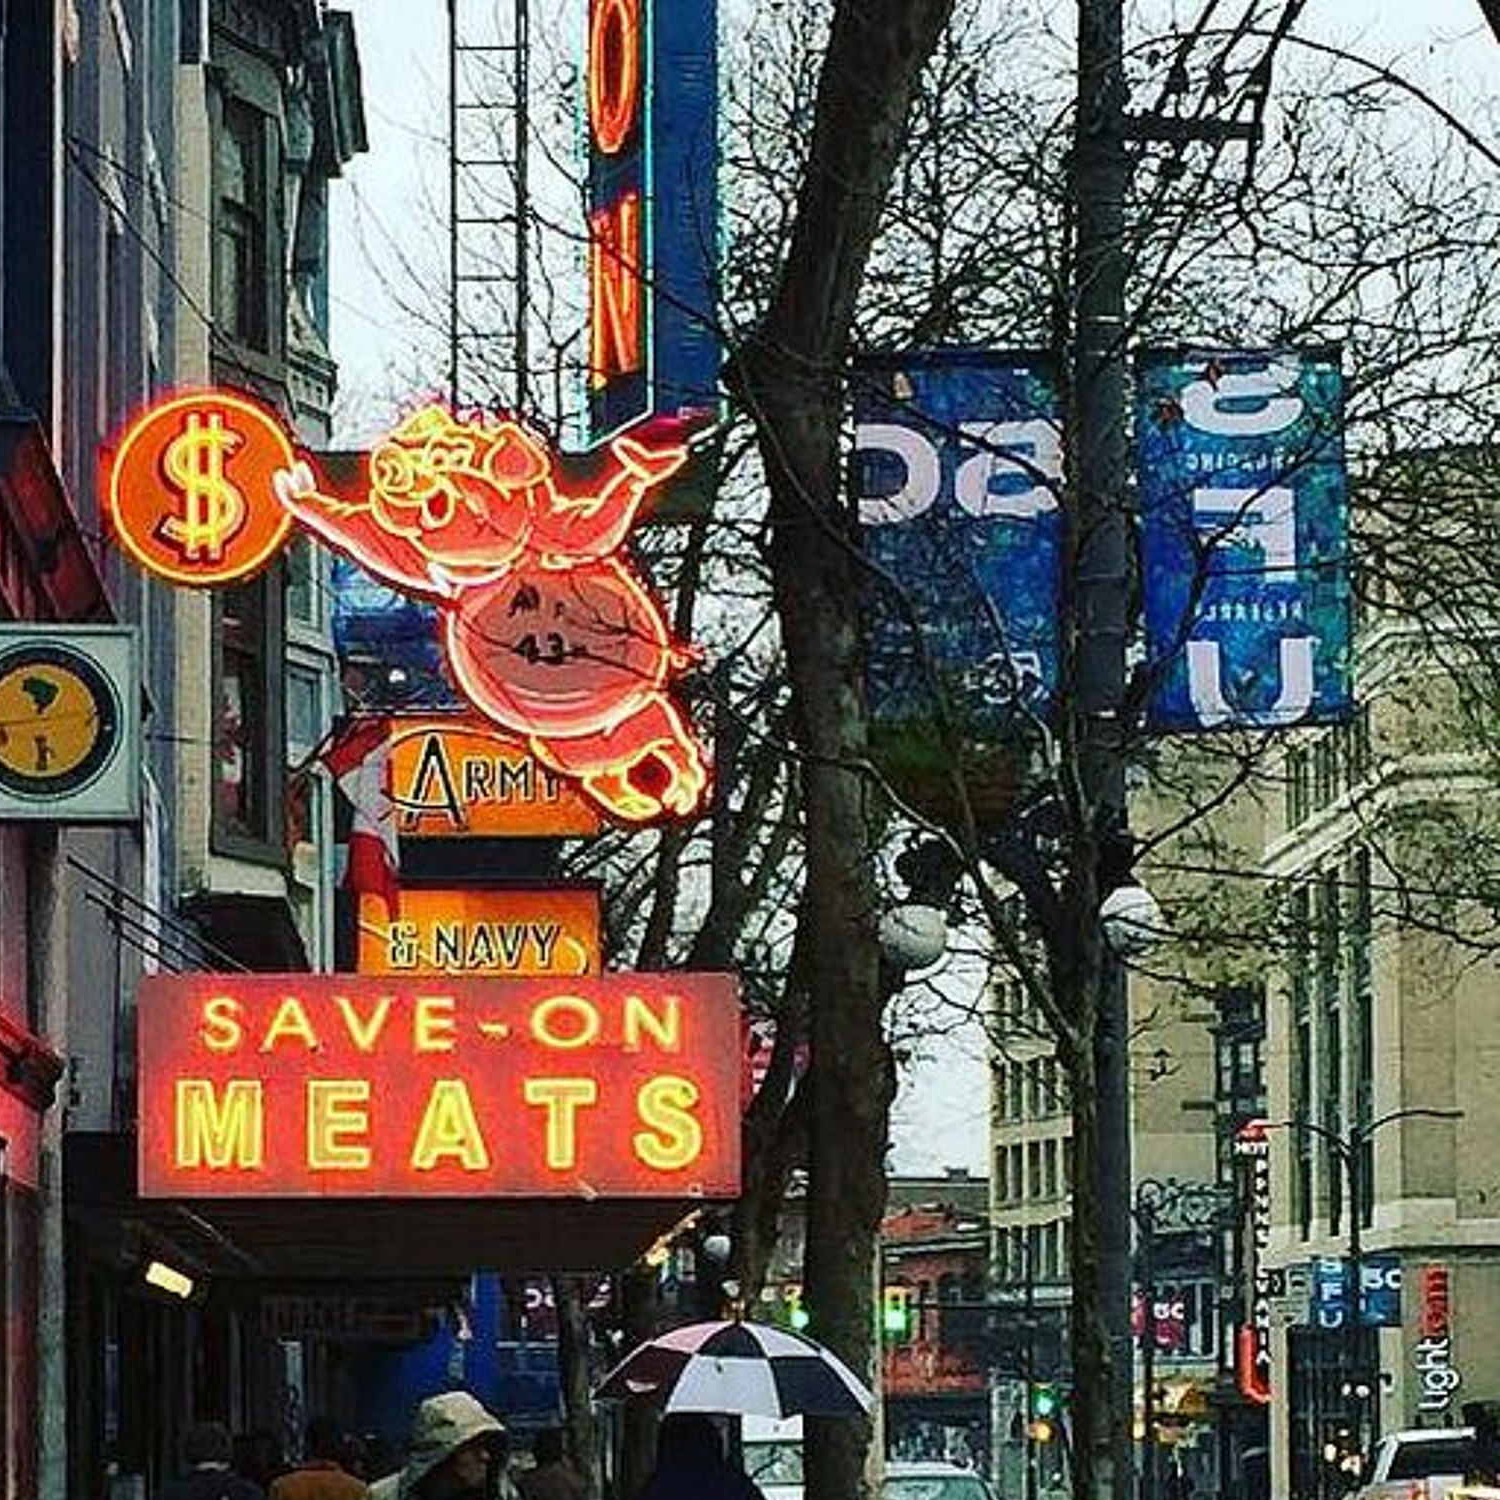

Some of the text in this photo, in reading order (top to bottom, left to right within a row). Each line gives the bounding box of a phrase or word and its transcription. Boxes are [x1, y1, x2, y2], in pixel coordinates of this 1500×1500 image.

[153, 409, 247, 561] $
[402, 732, 562, 833] ARMY
[431, 920, 561, 969] NAVY
[198, 994, 682, 1053] SAVE-ON
[176, 1074, 704, 1171] MEATS
